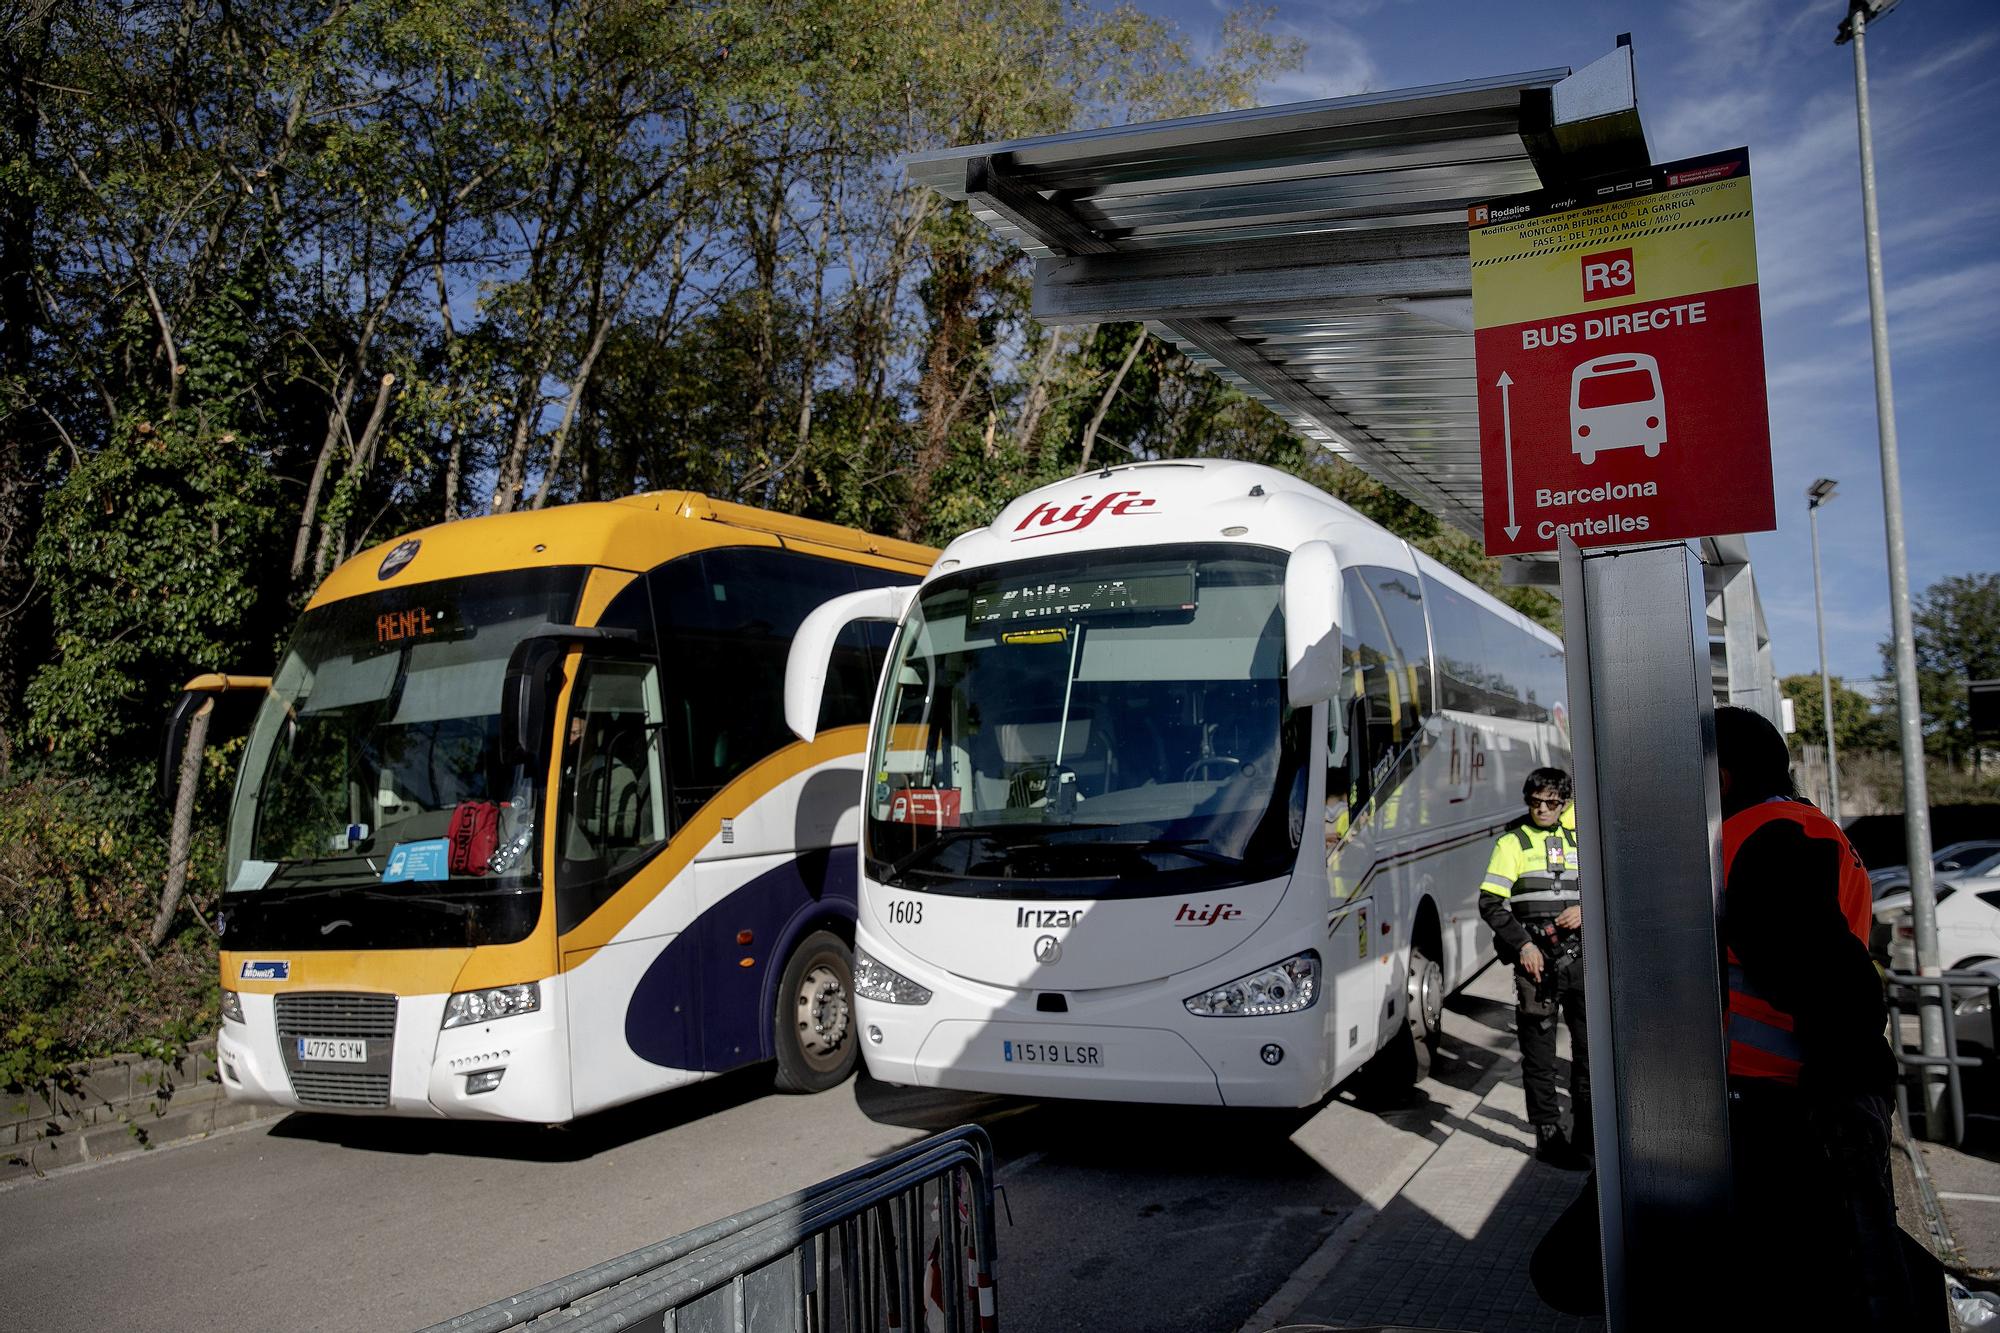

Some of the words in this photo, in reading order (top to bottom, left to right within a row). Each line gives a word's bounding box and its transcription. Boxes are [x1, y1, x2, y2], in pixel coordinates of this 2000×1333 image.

[1481, 222, 1525, 236] Modificació
[1527, 217, 1540, 228] del
[1542, 214, 1565, 225] servei
[1567, 211, 1580, 222] per
[1582, 207, 1604, 217] obres
[1610, 195, 1657, 211] Modificación
[1659, 191, 1670, 201] del
[1672, 187, 1699, 200] servicio
[1701, 185, 1714, 196] por
[1716, 181, 1737, 191] obras
[1491, 204, 1531, 219] Rodalies
[1551, 198, 1577, 209] renfe
[1520, 224, 1570, 239] MONTCADA
[1572, 210, 1628, 229] BIFURCACIÓ
[1638, 207, 1649, 217] LA
[1651, 198, 1695, 213] GARRIGA
[1533, 236, 1554, 248] FASE
[1558, 235, 1566, 243] 1:
[1569, 231, 1585, 241] DEL
[1589, 225, 1611, 237] 7/10
[1612, 224, 1619, 233] A
[1621, 220, 1647, 231] MAIG
[1655, 212, 1681, 224] MAYO
[1585, 259, 1633, 292] R3
[1522, 323, 1577, 350] BUS
[1585, 301, 1707, 342] DIRECTE
[1535, 480, 1658, 508] Barcelona
[1011, 491, 1162, 542] hife
[1537, 514, 1650, 541] Centelles
[377, 607, 434, 642] RENFE
[888, 901, 923, 924] 1603
[1016, 907, 1084, 928] Irizar
[1174, 903, 1246, 927] hife
[307, 1041, 336, 1058] 4776
[1017, 1044, 1059, 1062] 1519
[1064, 1045, 1099, 1064] LSR
